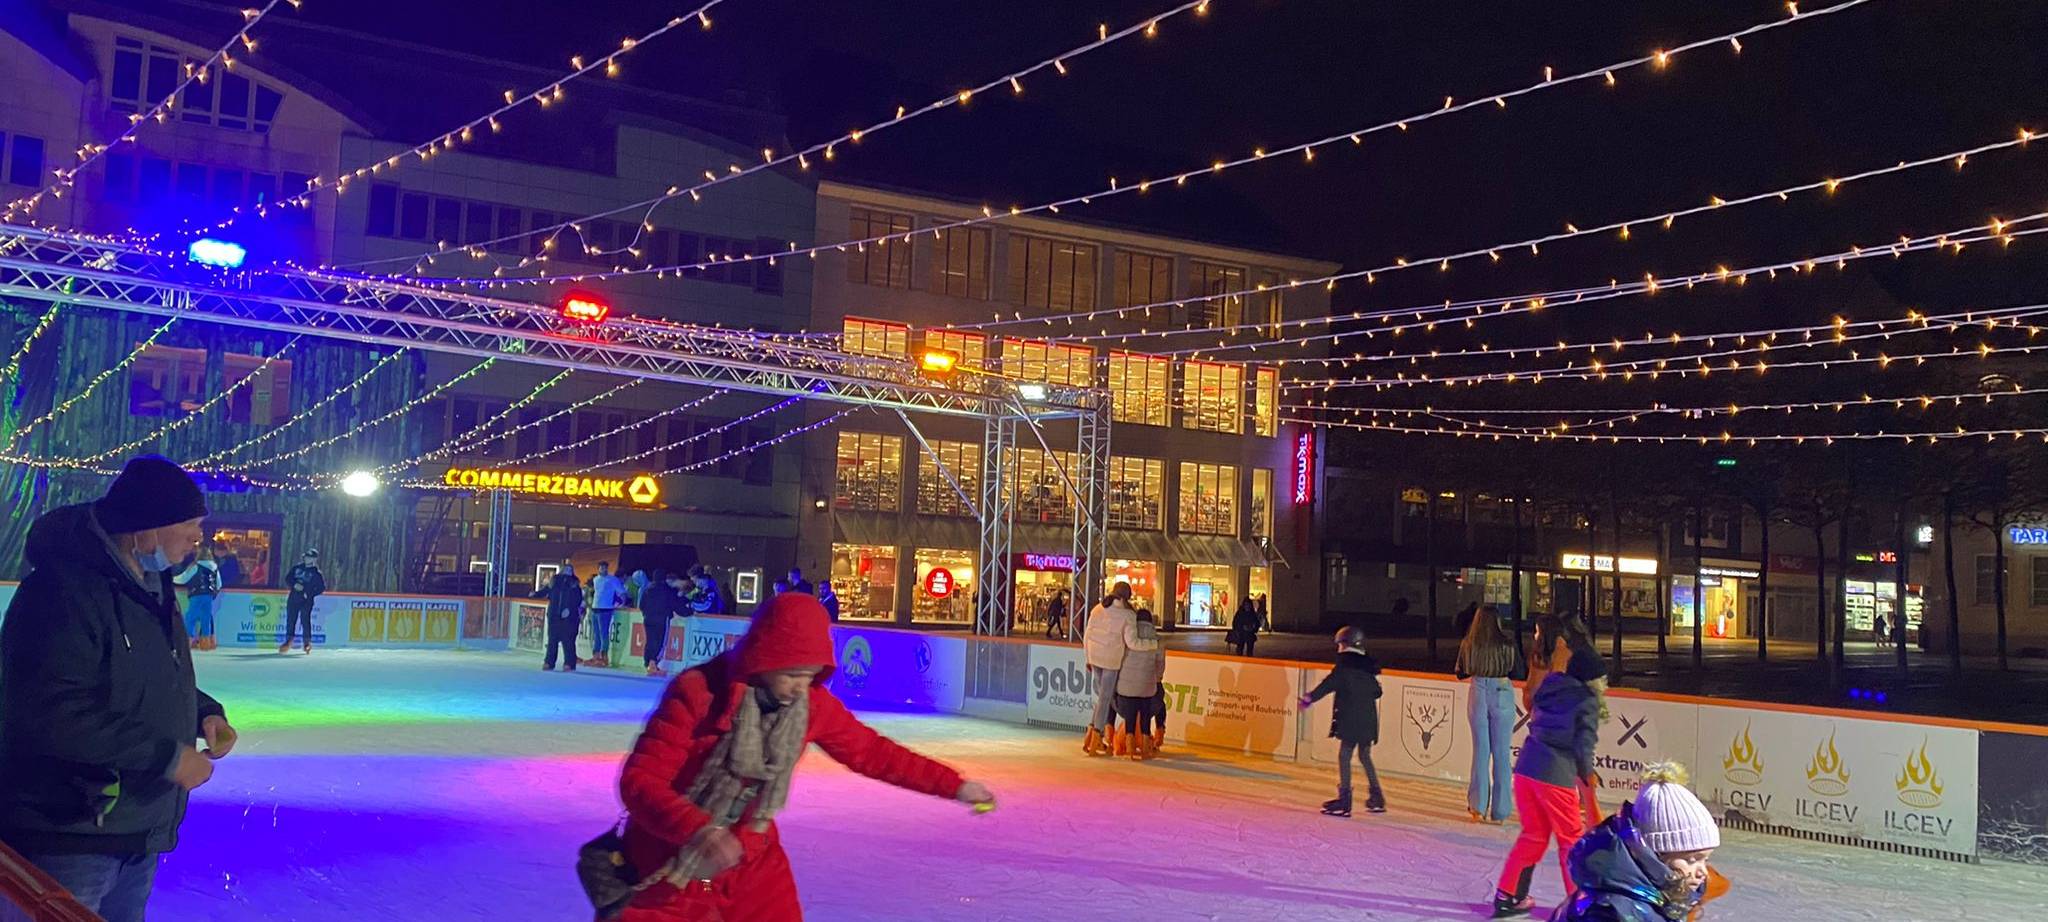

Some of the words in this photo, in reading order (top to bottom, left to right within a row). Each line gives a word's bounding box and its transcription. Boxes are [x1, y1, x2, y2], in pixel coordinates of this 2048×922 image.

[444, 468, 624, 498] COMMERZBANK
[352, 601, 385, 609] KAFFEE
[390, 602, 422, 610] KAFFEE
[241, 621, 257, 631] Wir
[1714, 787, 1772, 811] ILCEV
[1796, 798, 1858, 823] ILCEV
[1884, 810, 1953, 836] ILCEV
